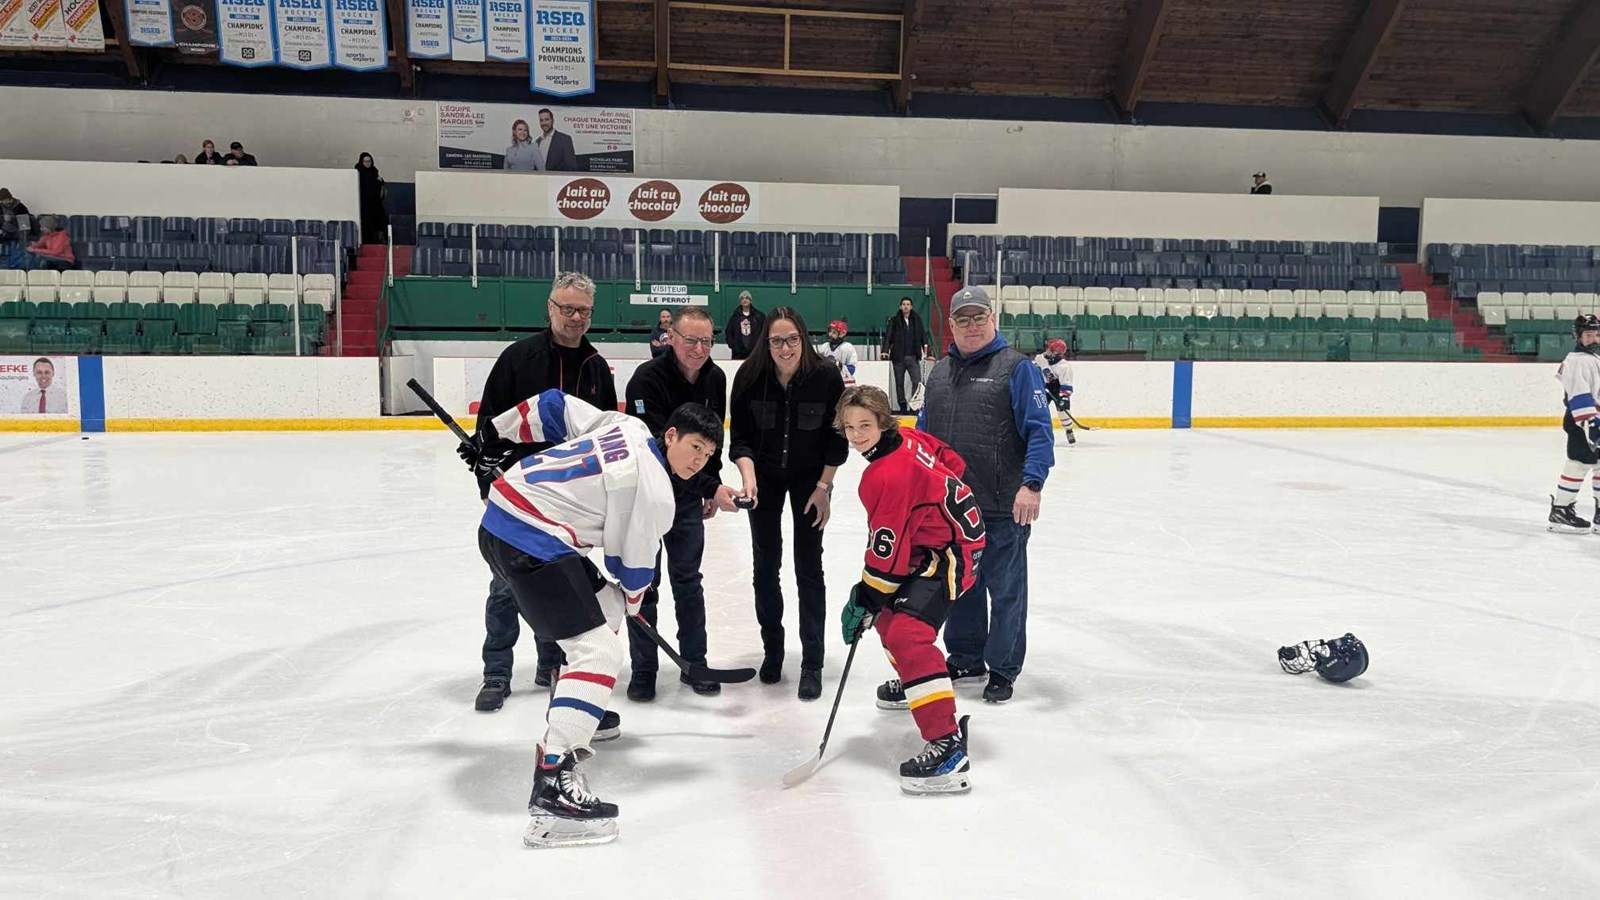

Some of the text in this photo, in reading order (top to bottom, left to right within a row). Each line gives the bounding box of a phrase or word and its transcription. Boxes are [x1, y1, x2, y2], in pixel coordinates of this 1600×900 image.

[336, 0, 378, 11] RSEQ
[412, 0, 445, 9] RSEQ
[489, 2, 522, 12] RSEQ
[536, 10, 586, 26] RSEQ
[227, 22, 264, 30] CHAMPIONS
[285, 25, 321, 33] CHAMPIONS
[415, 22, 443, 30] CHAMPIONS
[341, 28, 377, 36] CHAMPIONS
[541, 46, 583, 55] CHAMPIONS
[346, 52, 365, 60] sports
[538, 54, 586, 63] PROVINCIAUX
[554, 79, 579, 87] experts
[590, 117, 632, 125] TRANSACTION
[567, 186, 605, 198] lait au
[638, 187, 676, 200] lait au
[707, 190, 746, 202] lait au
[557, 198, 609, 210] chocolat
[628, 200, 679, 212] chocolat
[698, 202, 748, 214] chocolat
[652, 285, 687, 293] VISITEUR
[597, 426, 630, 465] YANG
[520, 439, 603, 485] 27
